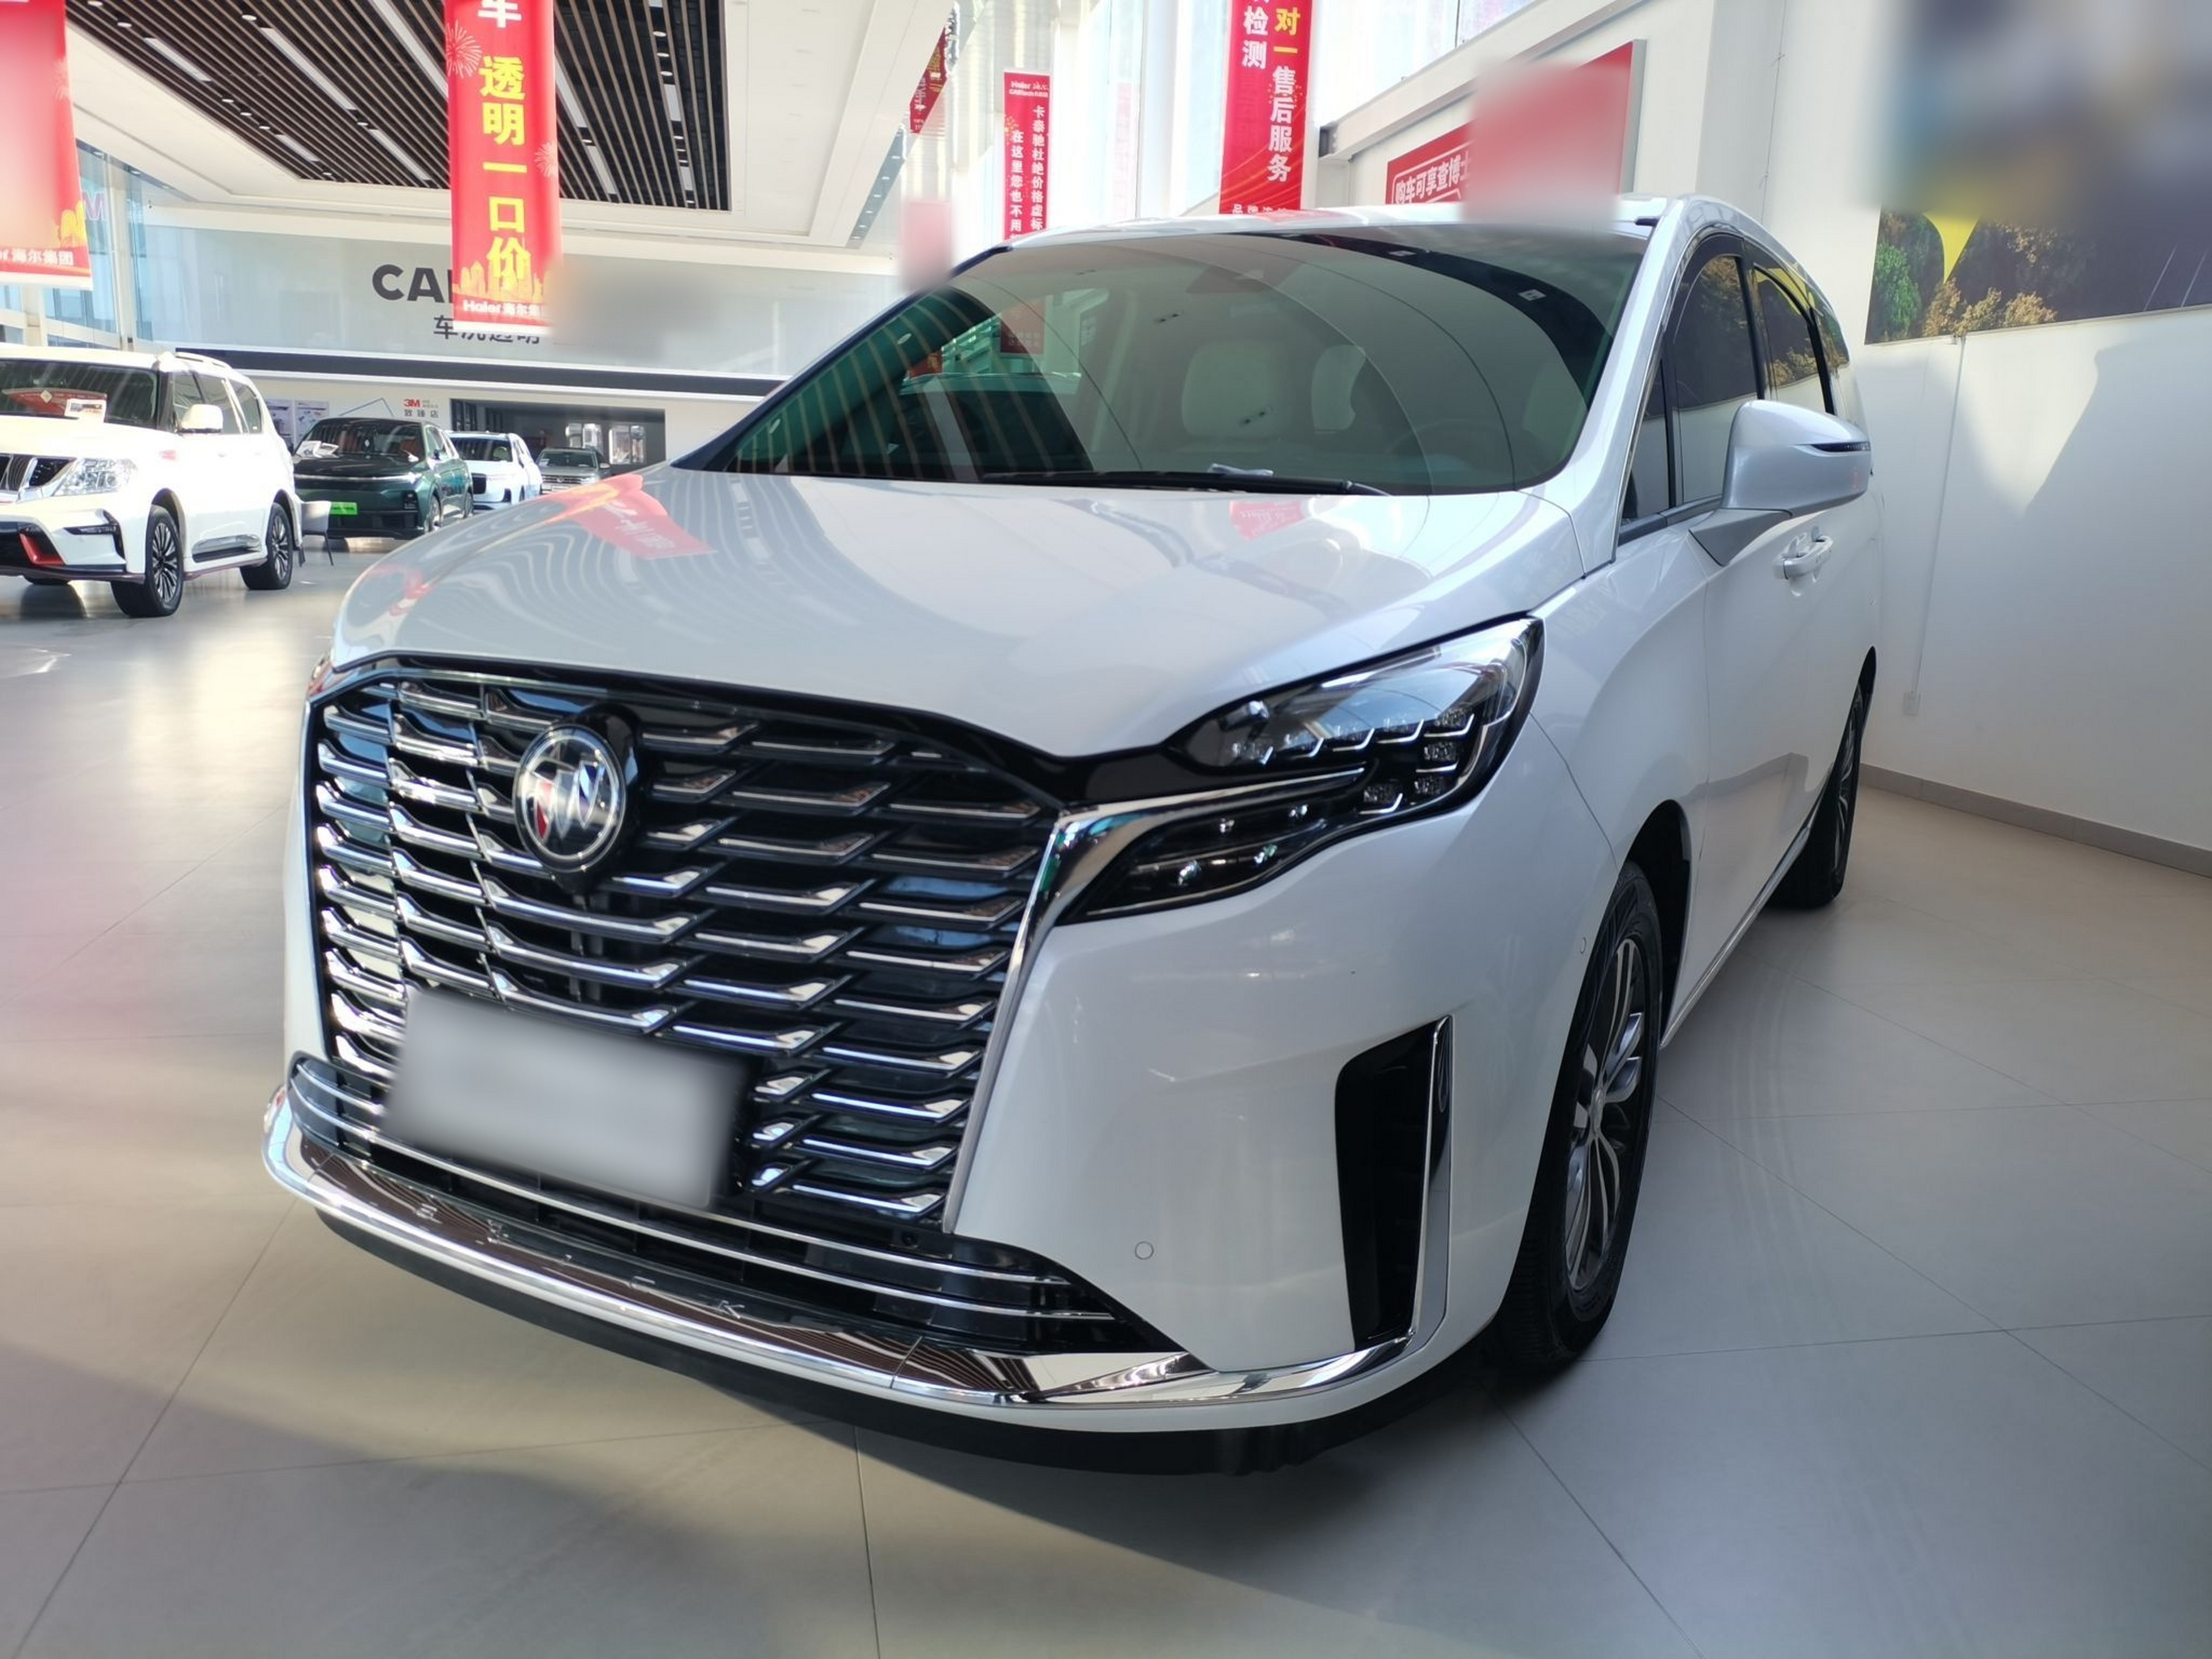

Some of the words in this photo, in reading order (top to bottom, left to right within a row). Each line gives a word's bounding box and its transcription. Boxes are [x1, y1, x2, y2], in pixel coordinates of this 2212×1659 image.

[1242, 0, 1269, 69] 检测
[479, 55, 531, 279] 透明一口价
[372, 264, 453, 304] CA
[463, 300, 501, 313] Haier
[502, 302, 543, 317] 海尔集
[404, 399, 420, 407] 3M
